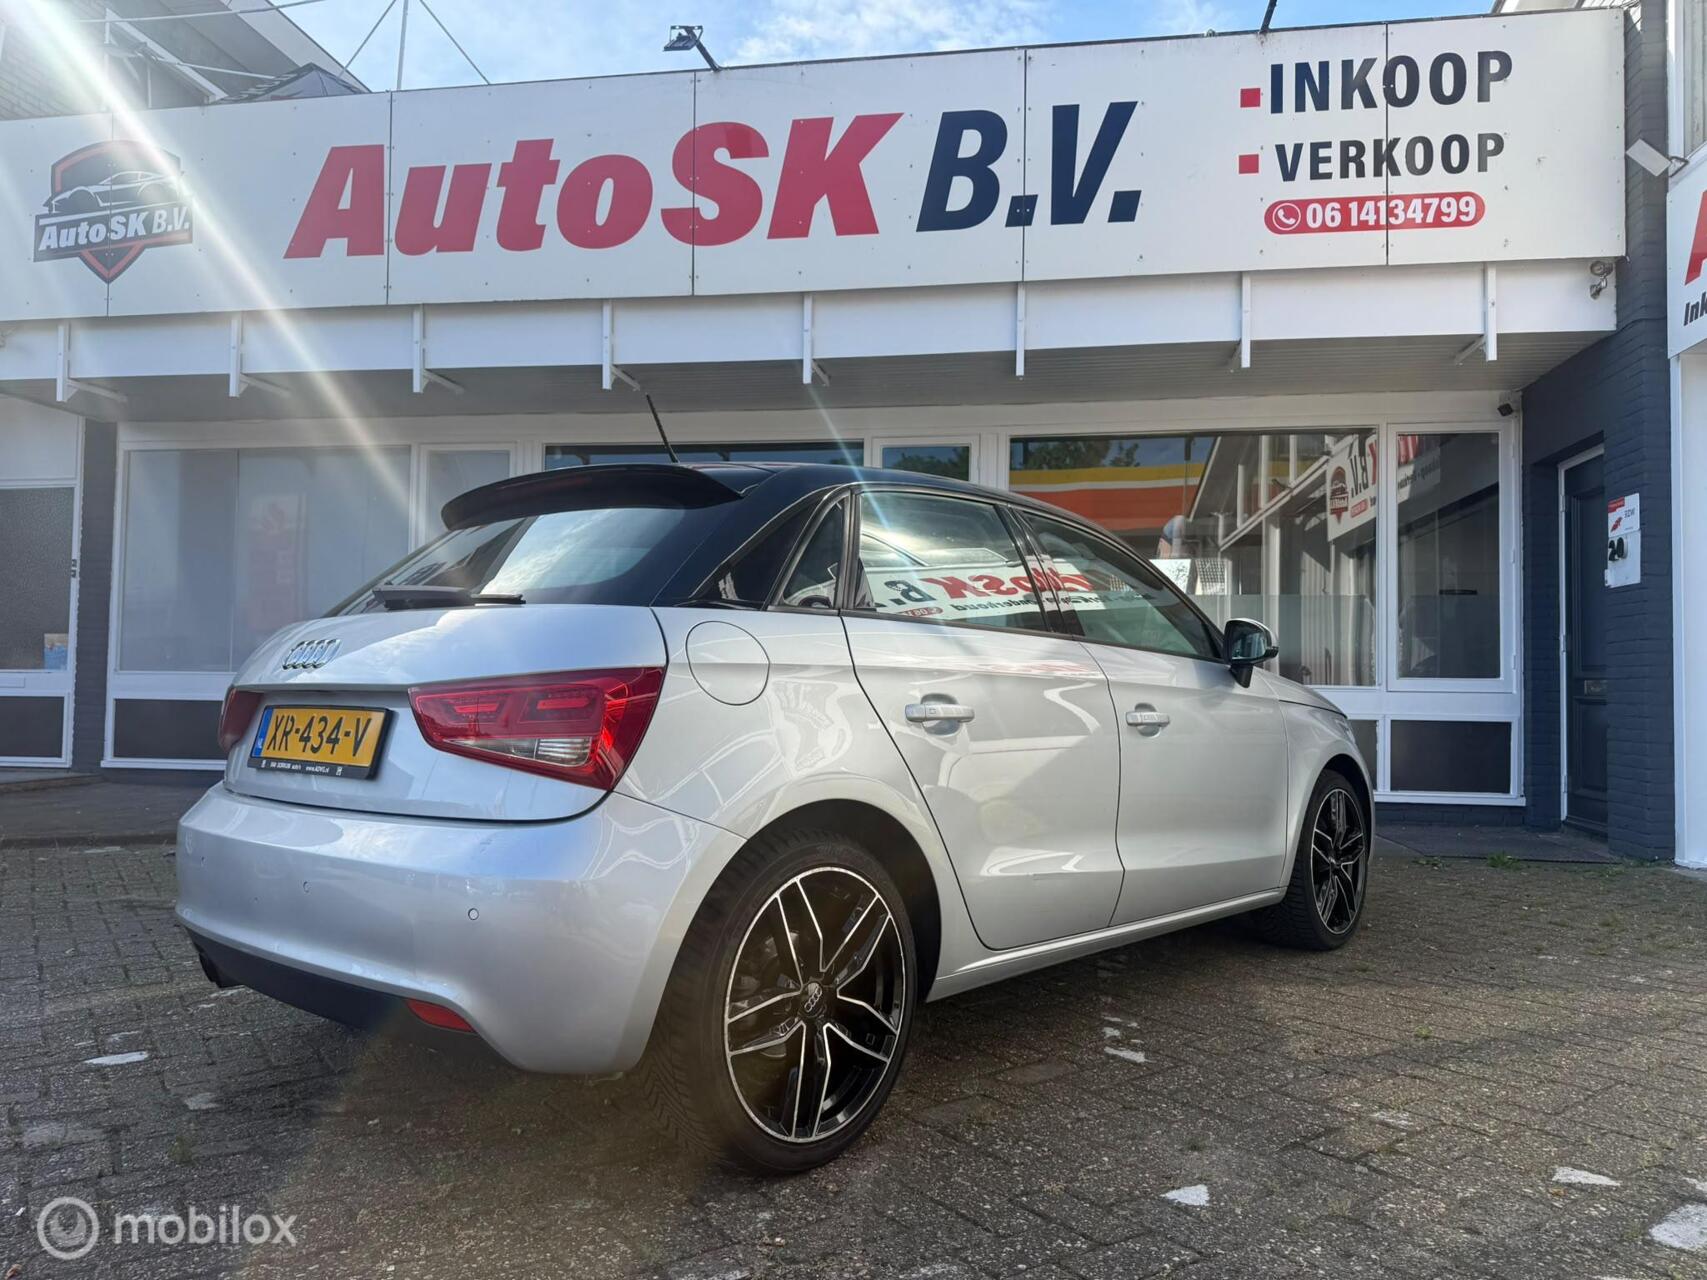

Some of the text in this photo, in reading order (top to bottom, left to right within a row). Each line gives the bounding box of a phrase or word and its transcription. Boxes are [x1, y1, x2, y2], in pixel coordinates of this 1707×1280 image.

[1270, 50, 1513, 114] INKOOP
[283, 100, 1142, 259] AutoSK B.V.
[1275, 132, 1505, 182] VERKOOP
[38, 206, 190, 251] AutoSK B.V.
[1306, 195, 1477, 229] 06 14134799
[266, 714, 372, 757] XR-434-V
